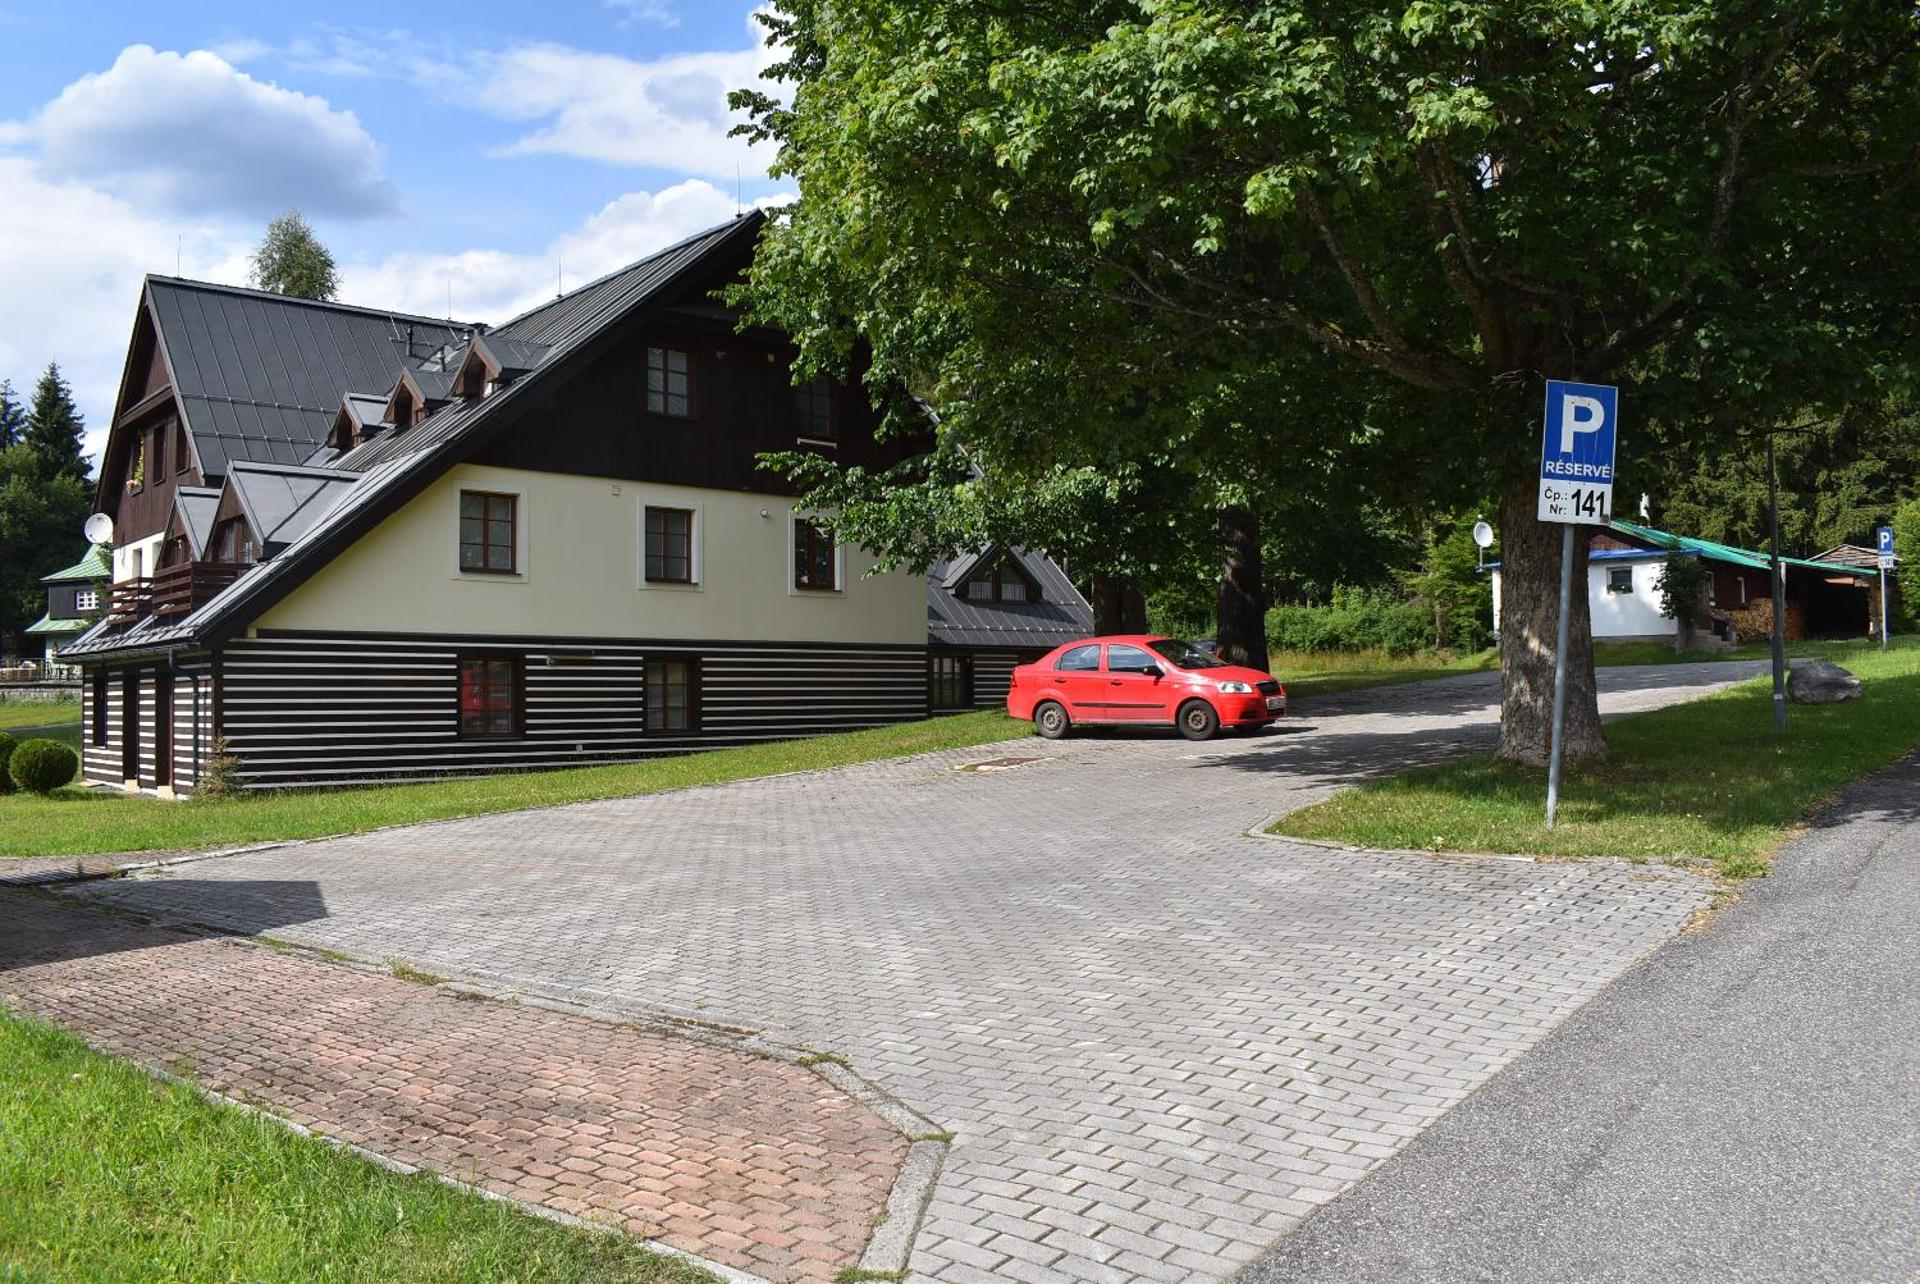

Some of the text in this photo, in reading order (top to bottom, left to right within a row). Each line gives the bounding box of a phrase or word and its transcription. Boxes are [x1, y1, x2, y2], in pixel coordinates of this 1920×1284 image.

[1560, 394, 1605, 453] P
[1545, 460, 1611, 478] RÉSERVÉ
[1549, 504, 1568, 515] Nr:
[1571, 489, 1605, 518] 141
[1880, 532, 1890, 549] P
